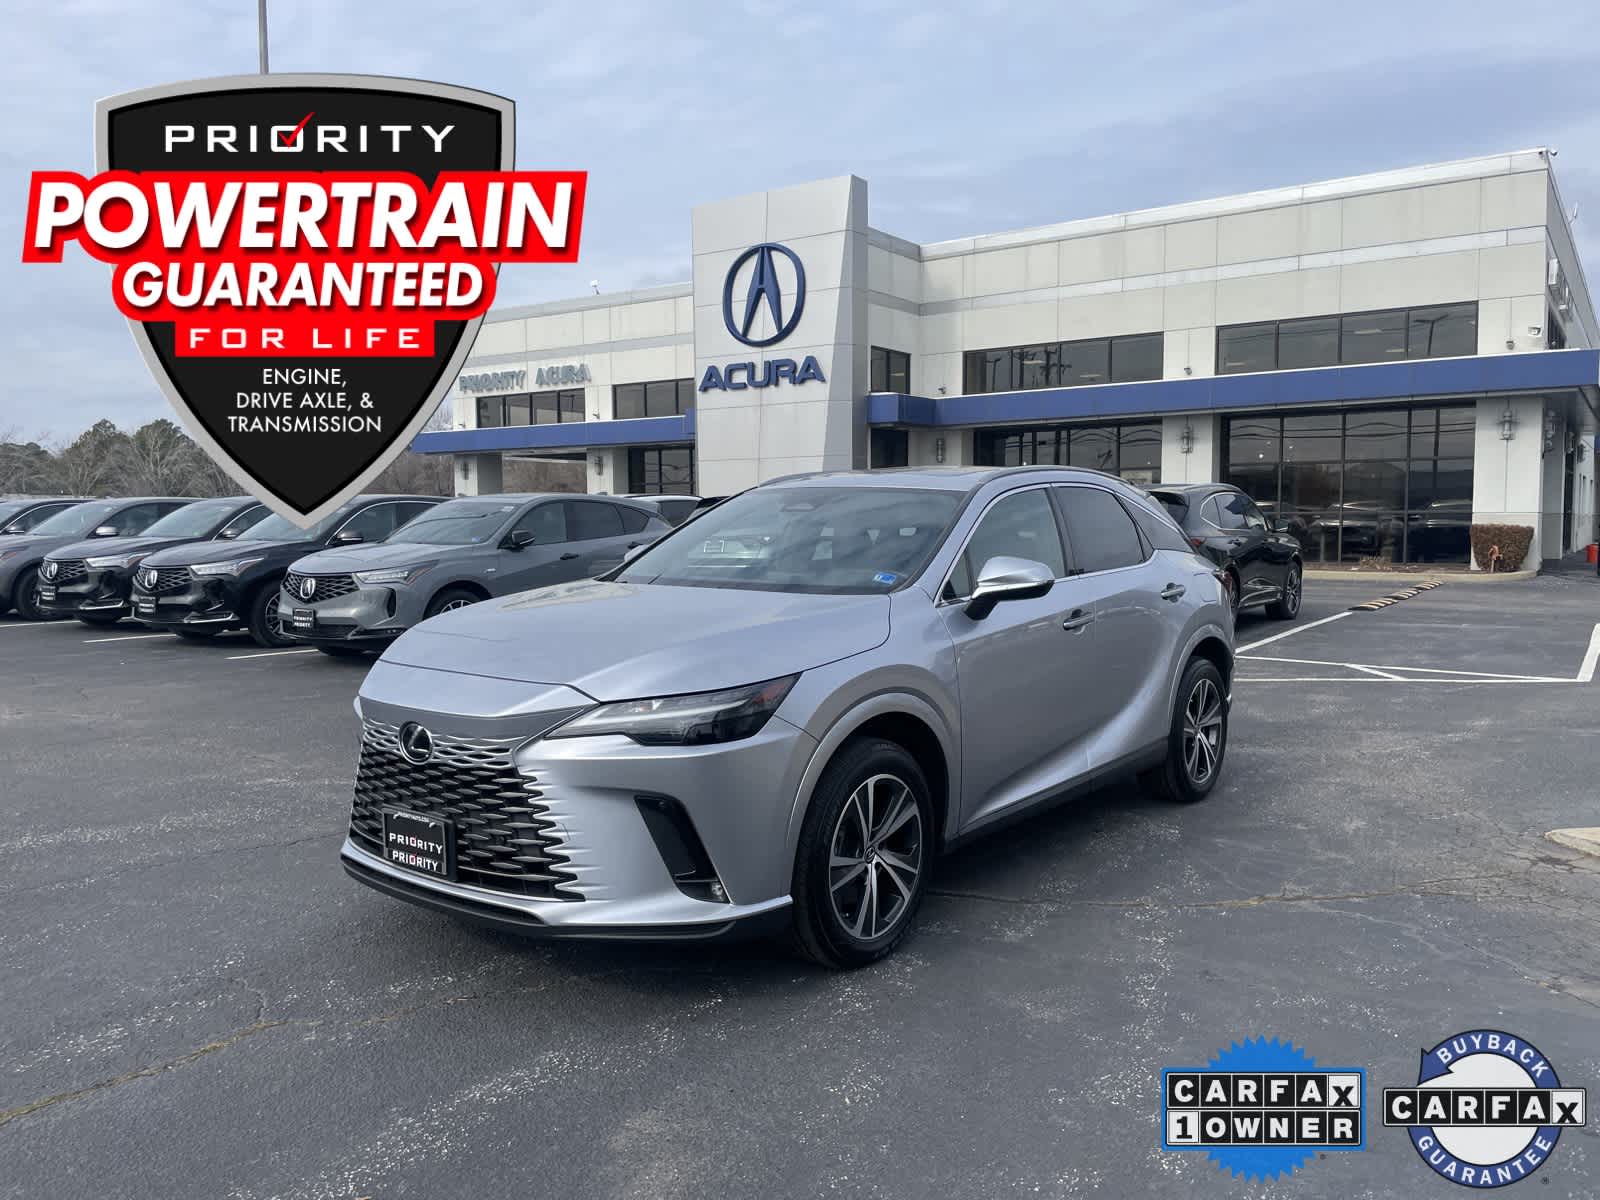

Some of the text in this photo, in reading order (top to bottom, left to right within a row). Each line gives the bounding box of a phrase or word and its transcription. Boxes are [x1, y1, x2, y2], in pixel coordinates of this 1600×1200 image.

[459, 364, 592, 392] PRIORITY ACURA
[698, 355, 826, 393] ACURA
[389, 832, 442, 854] PRIORITY
[392, 850, 438, 871] PRIORITY
